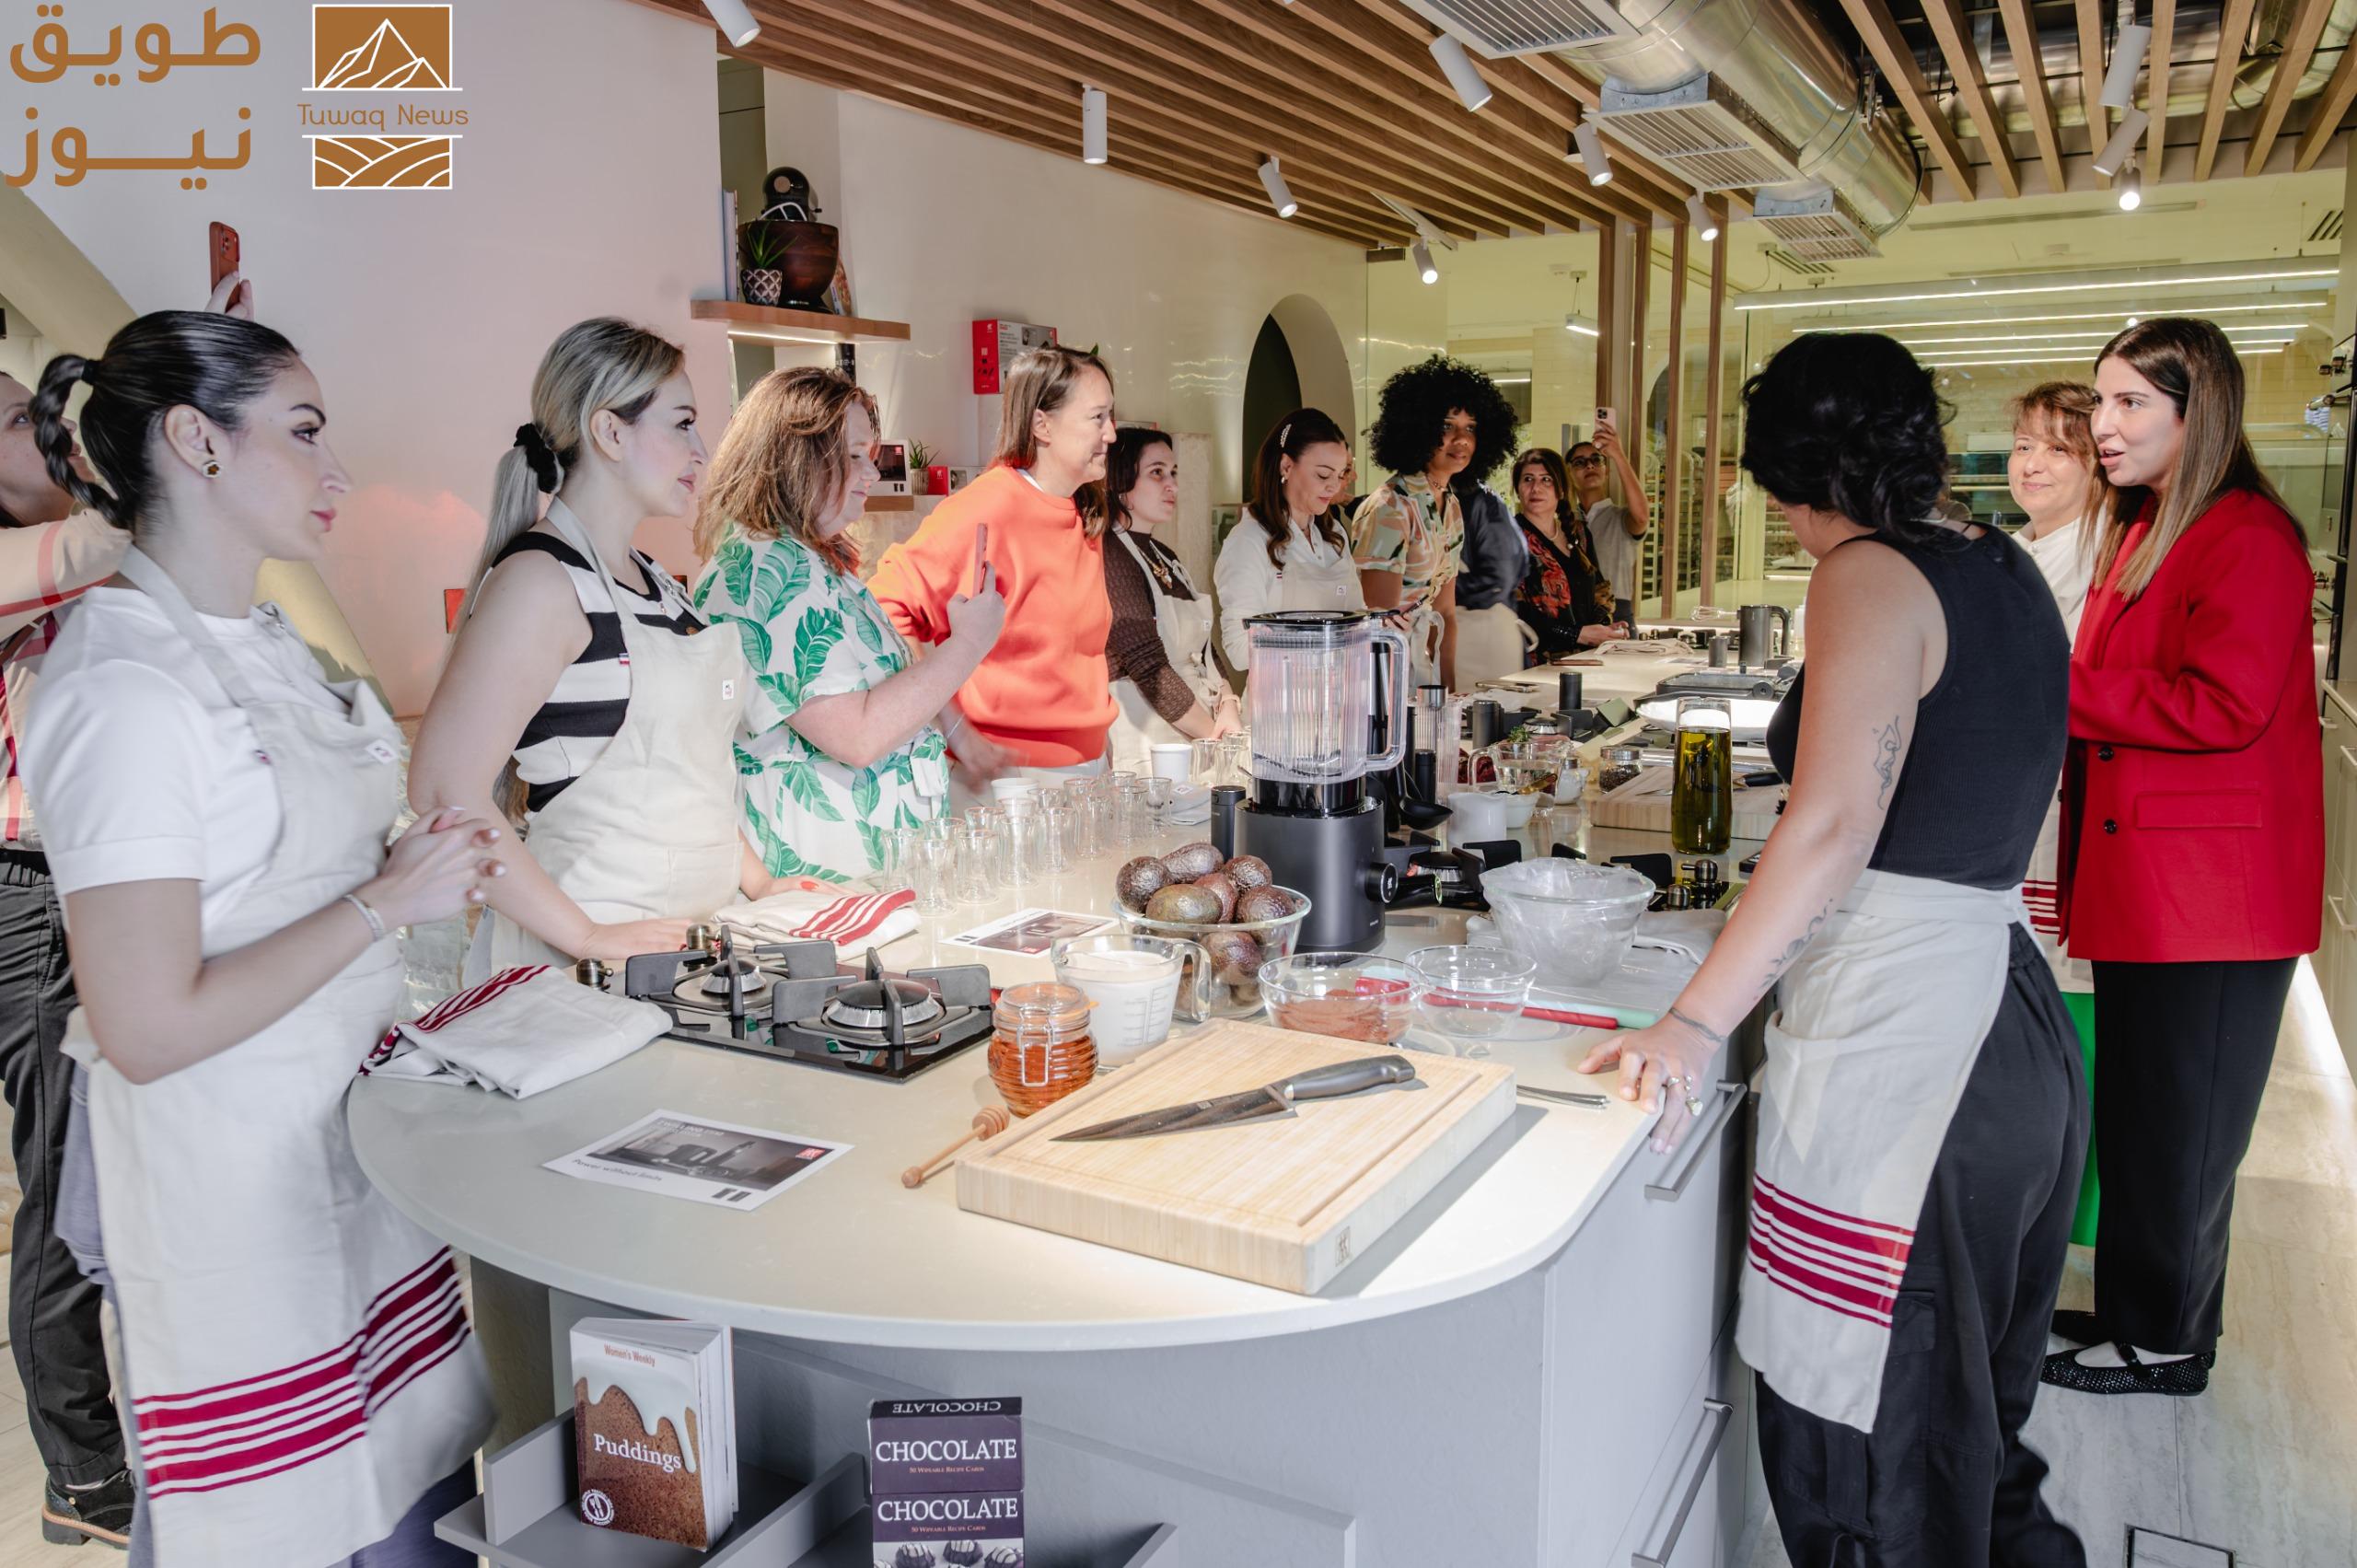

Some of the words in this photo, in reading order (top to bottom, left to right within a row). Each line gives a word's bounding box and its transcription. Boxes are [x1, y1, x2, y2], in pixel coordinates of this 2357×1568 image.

[603, 1342, 632, 1360] Women's
[632, 1350, 656, 1367] Weekly
[892, 1400, 1002, 1413] CHOCOLATE
[593, 1433, 682, 1473] Puddings
[875, 1438, 1017, 1462] CHOCOLATE
[877, 1497, 1018, 1522] CHOCOLATE
